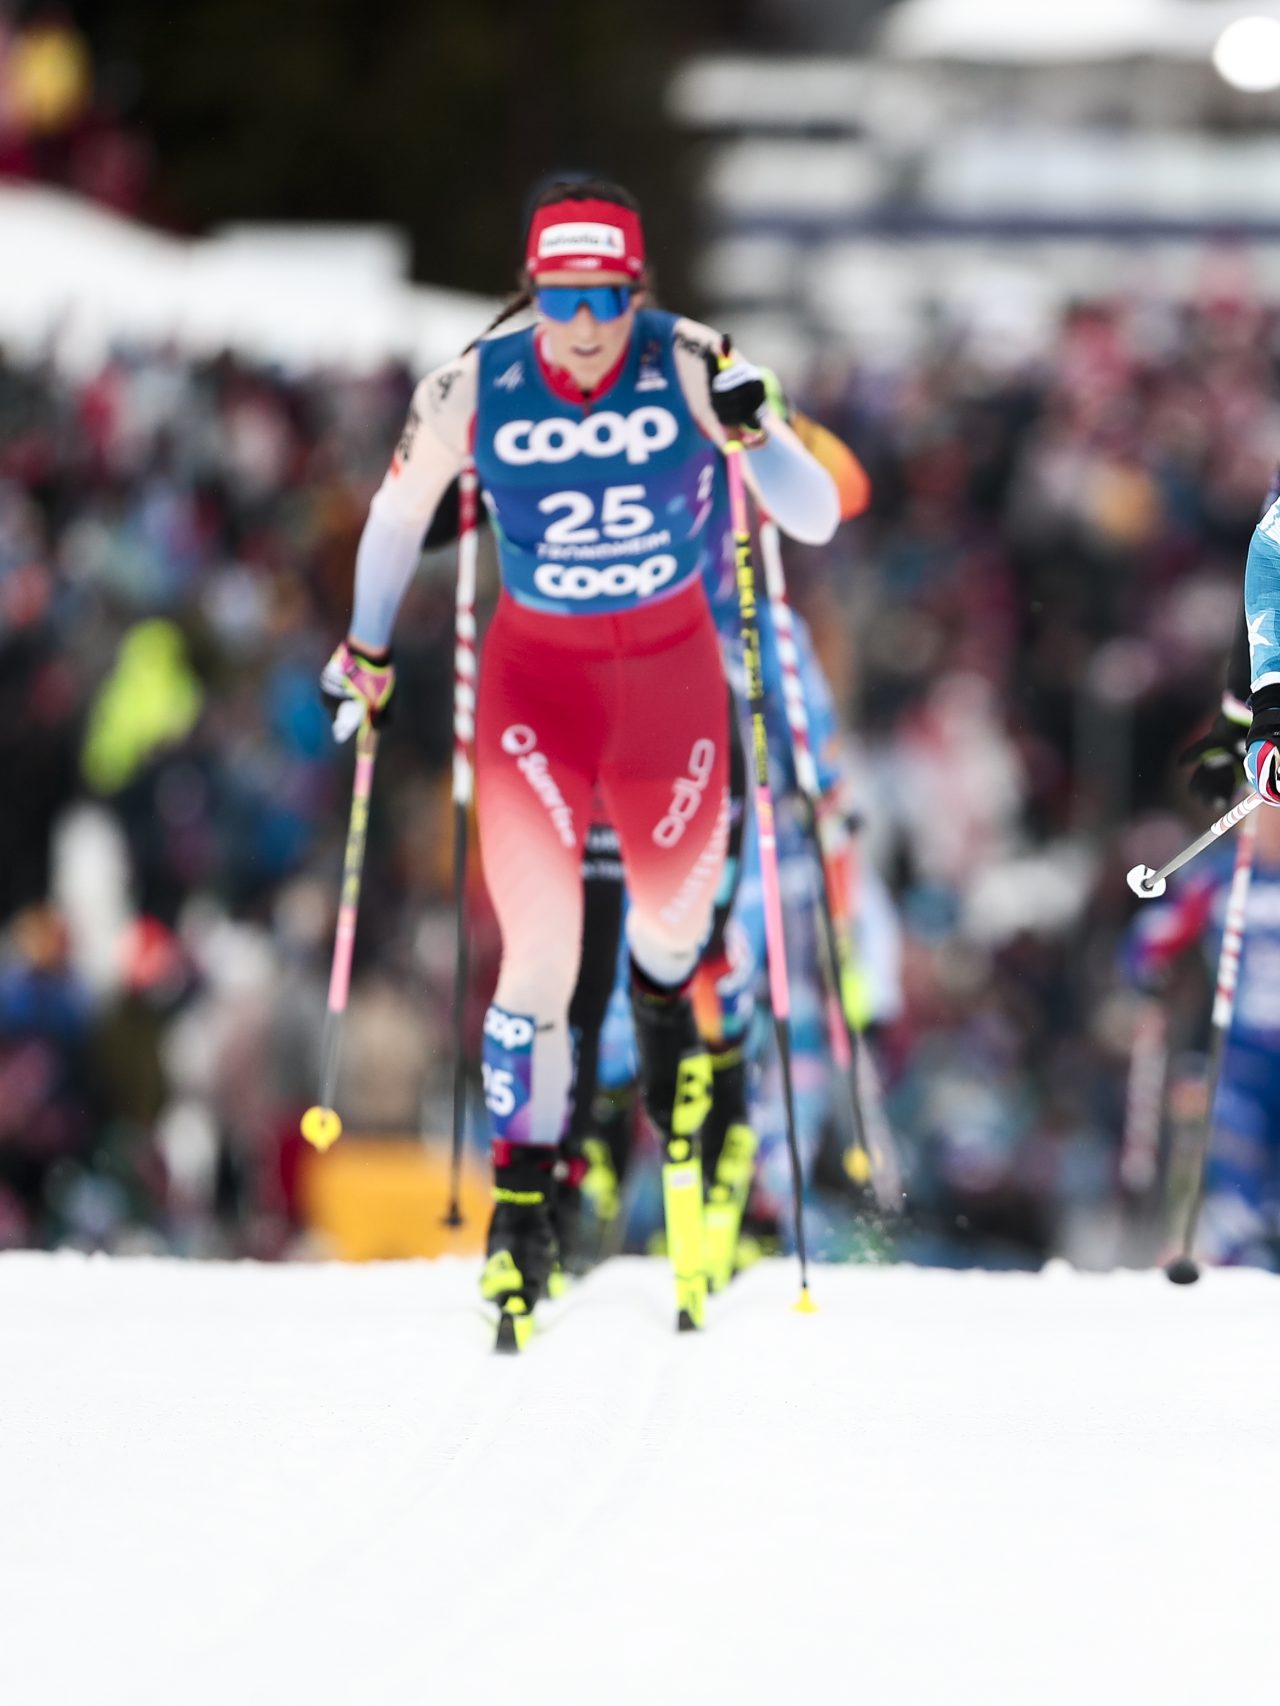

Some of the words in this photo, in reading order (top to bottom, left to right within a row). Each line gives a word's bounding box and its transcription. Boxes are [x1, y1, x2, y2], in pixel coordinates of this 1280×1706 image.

[494, 406, 679, 465] coop
[538, 485, 654, 544] 25
[537, 530, 671, 560] TRONDHEIM
[534, 554, 678, 600] coop
[652, 738, 715, 848] odlo
